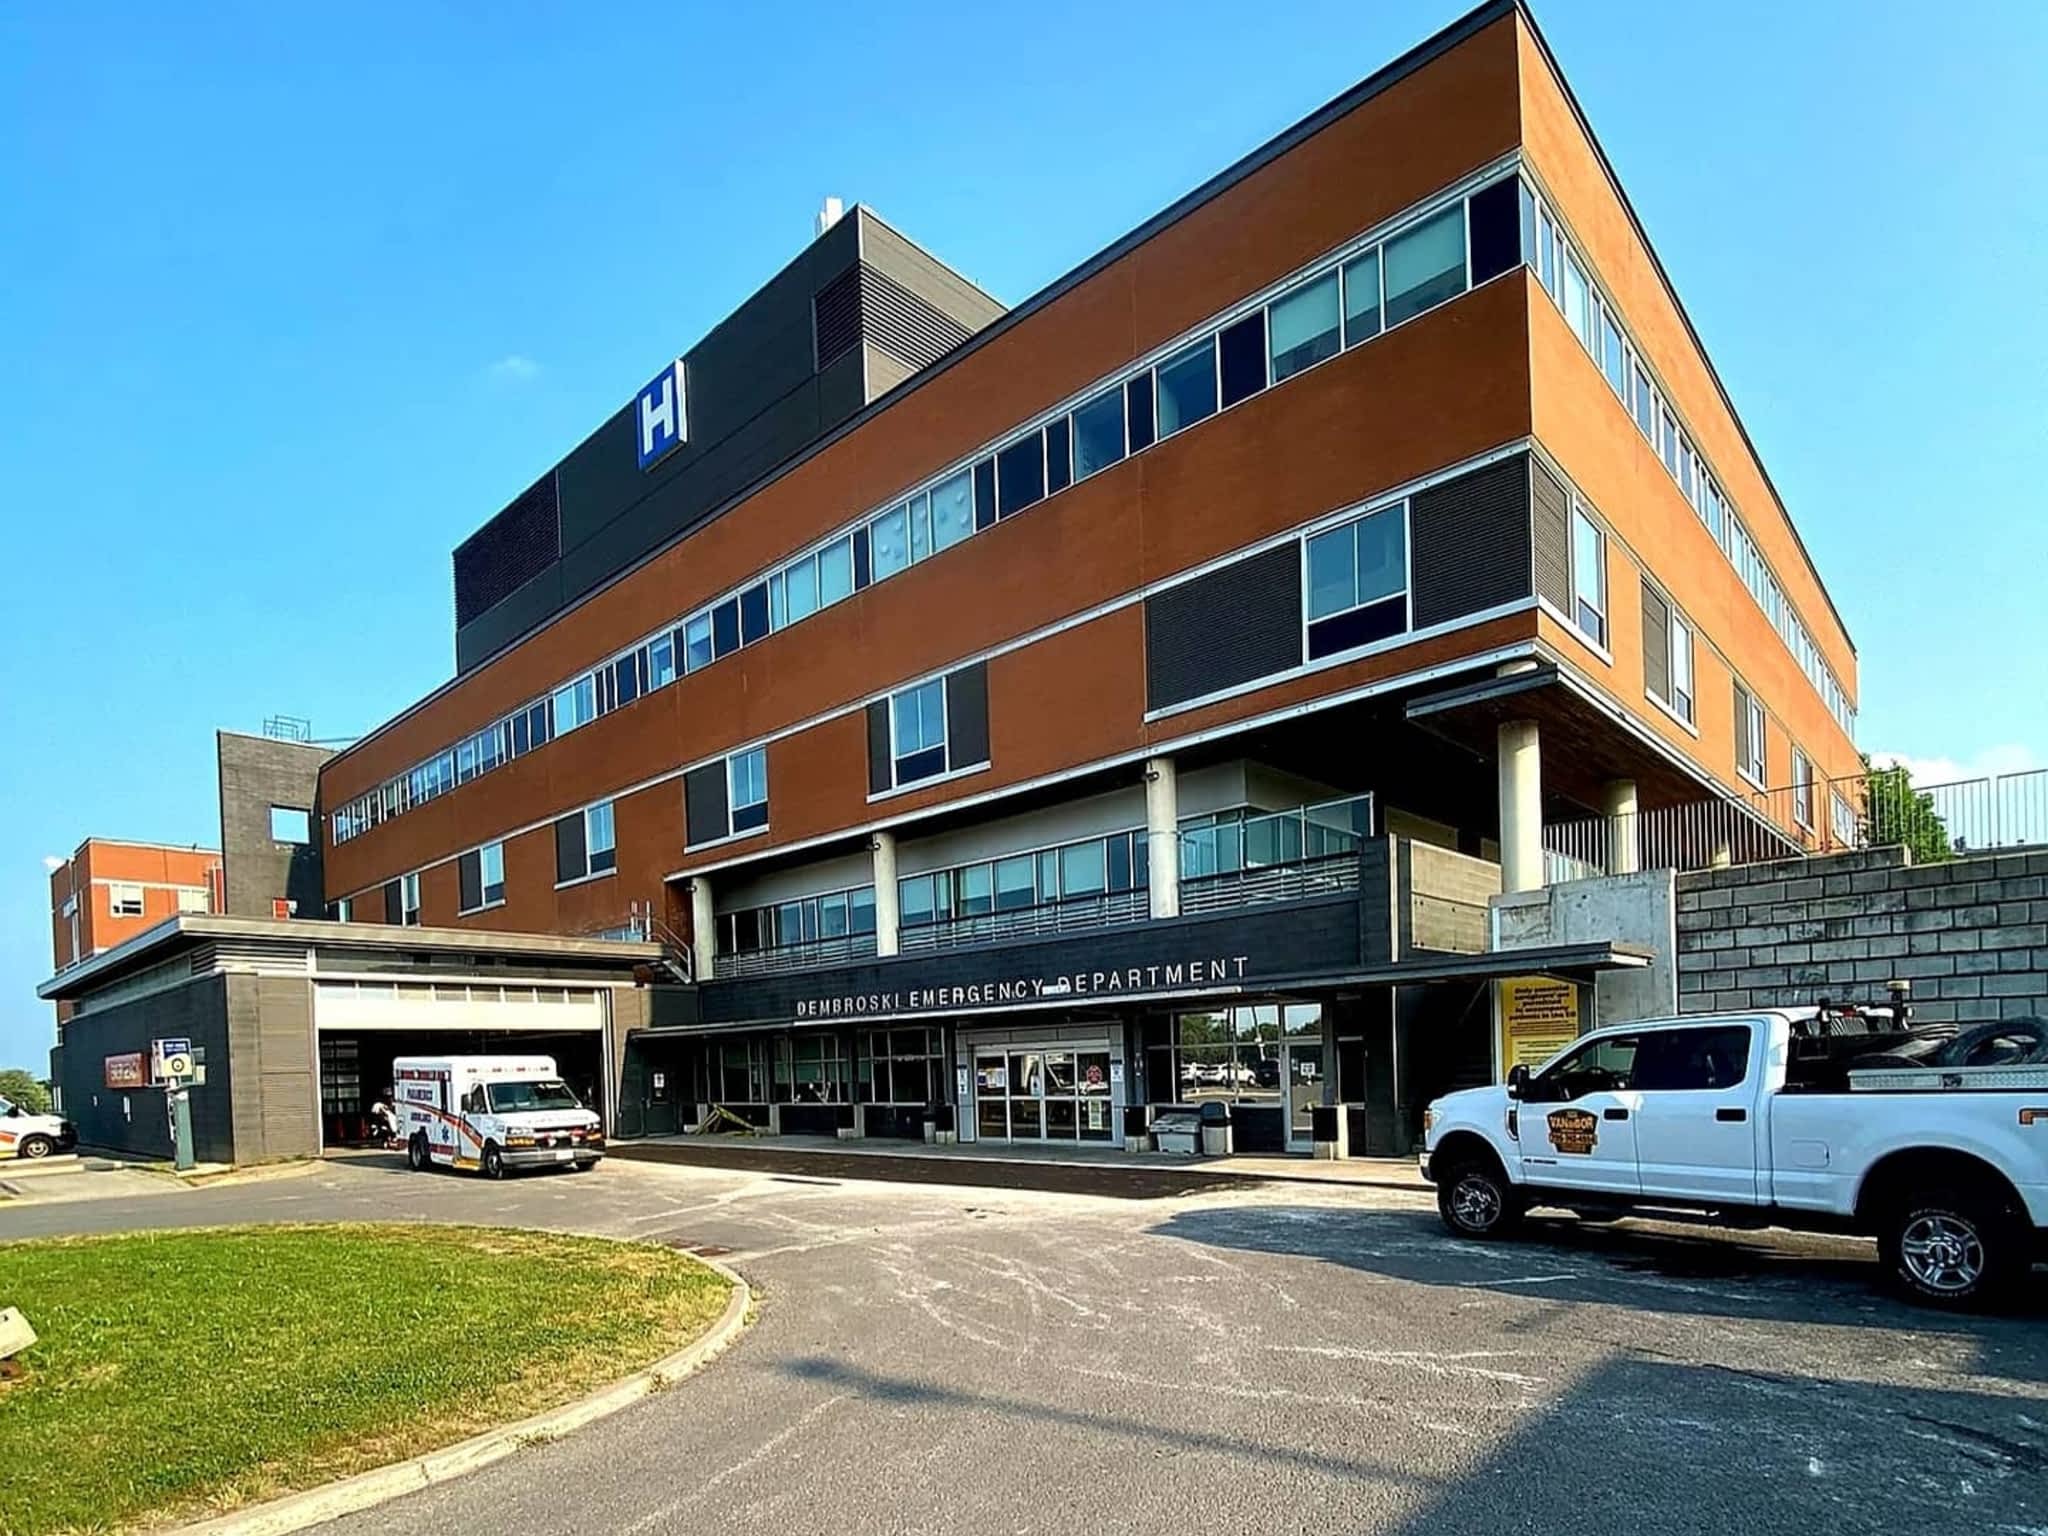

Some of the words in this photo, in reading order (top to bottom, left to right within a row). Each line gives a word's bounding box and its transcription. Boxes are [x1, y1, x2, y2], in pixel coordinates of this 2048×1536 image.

[642, 375, 674, 455] H
[797, 993, 900, 1016] DEMBROSKI
[909, 978, 1043, 1008] EMERGENCY
[1057, 957, 1248, 993] DEPARTMENT
